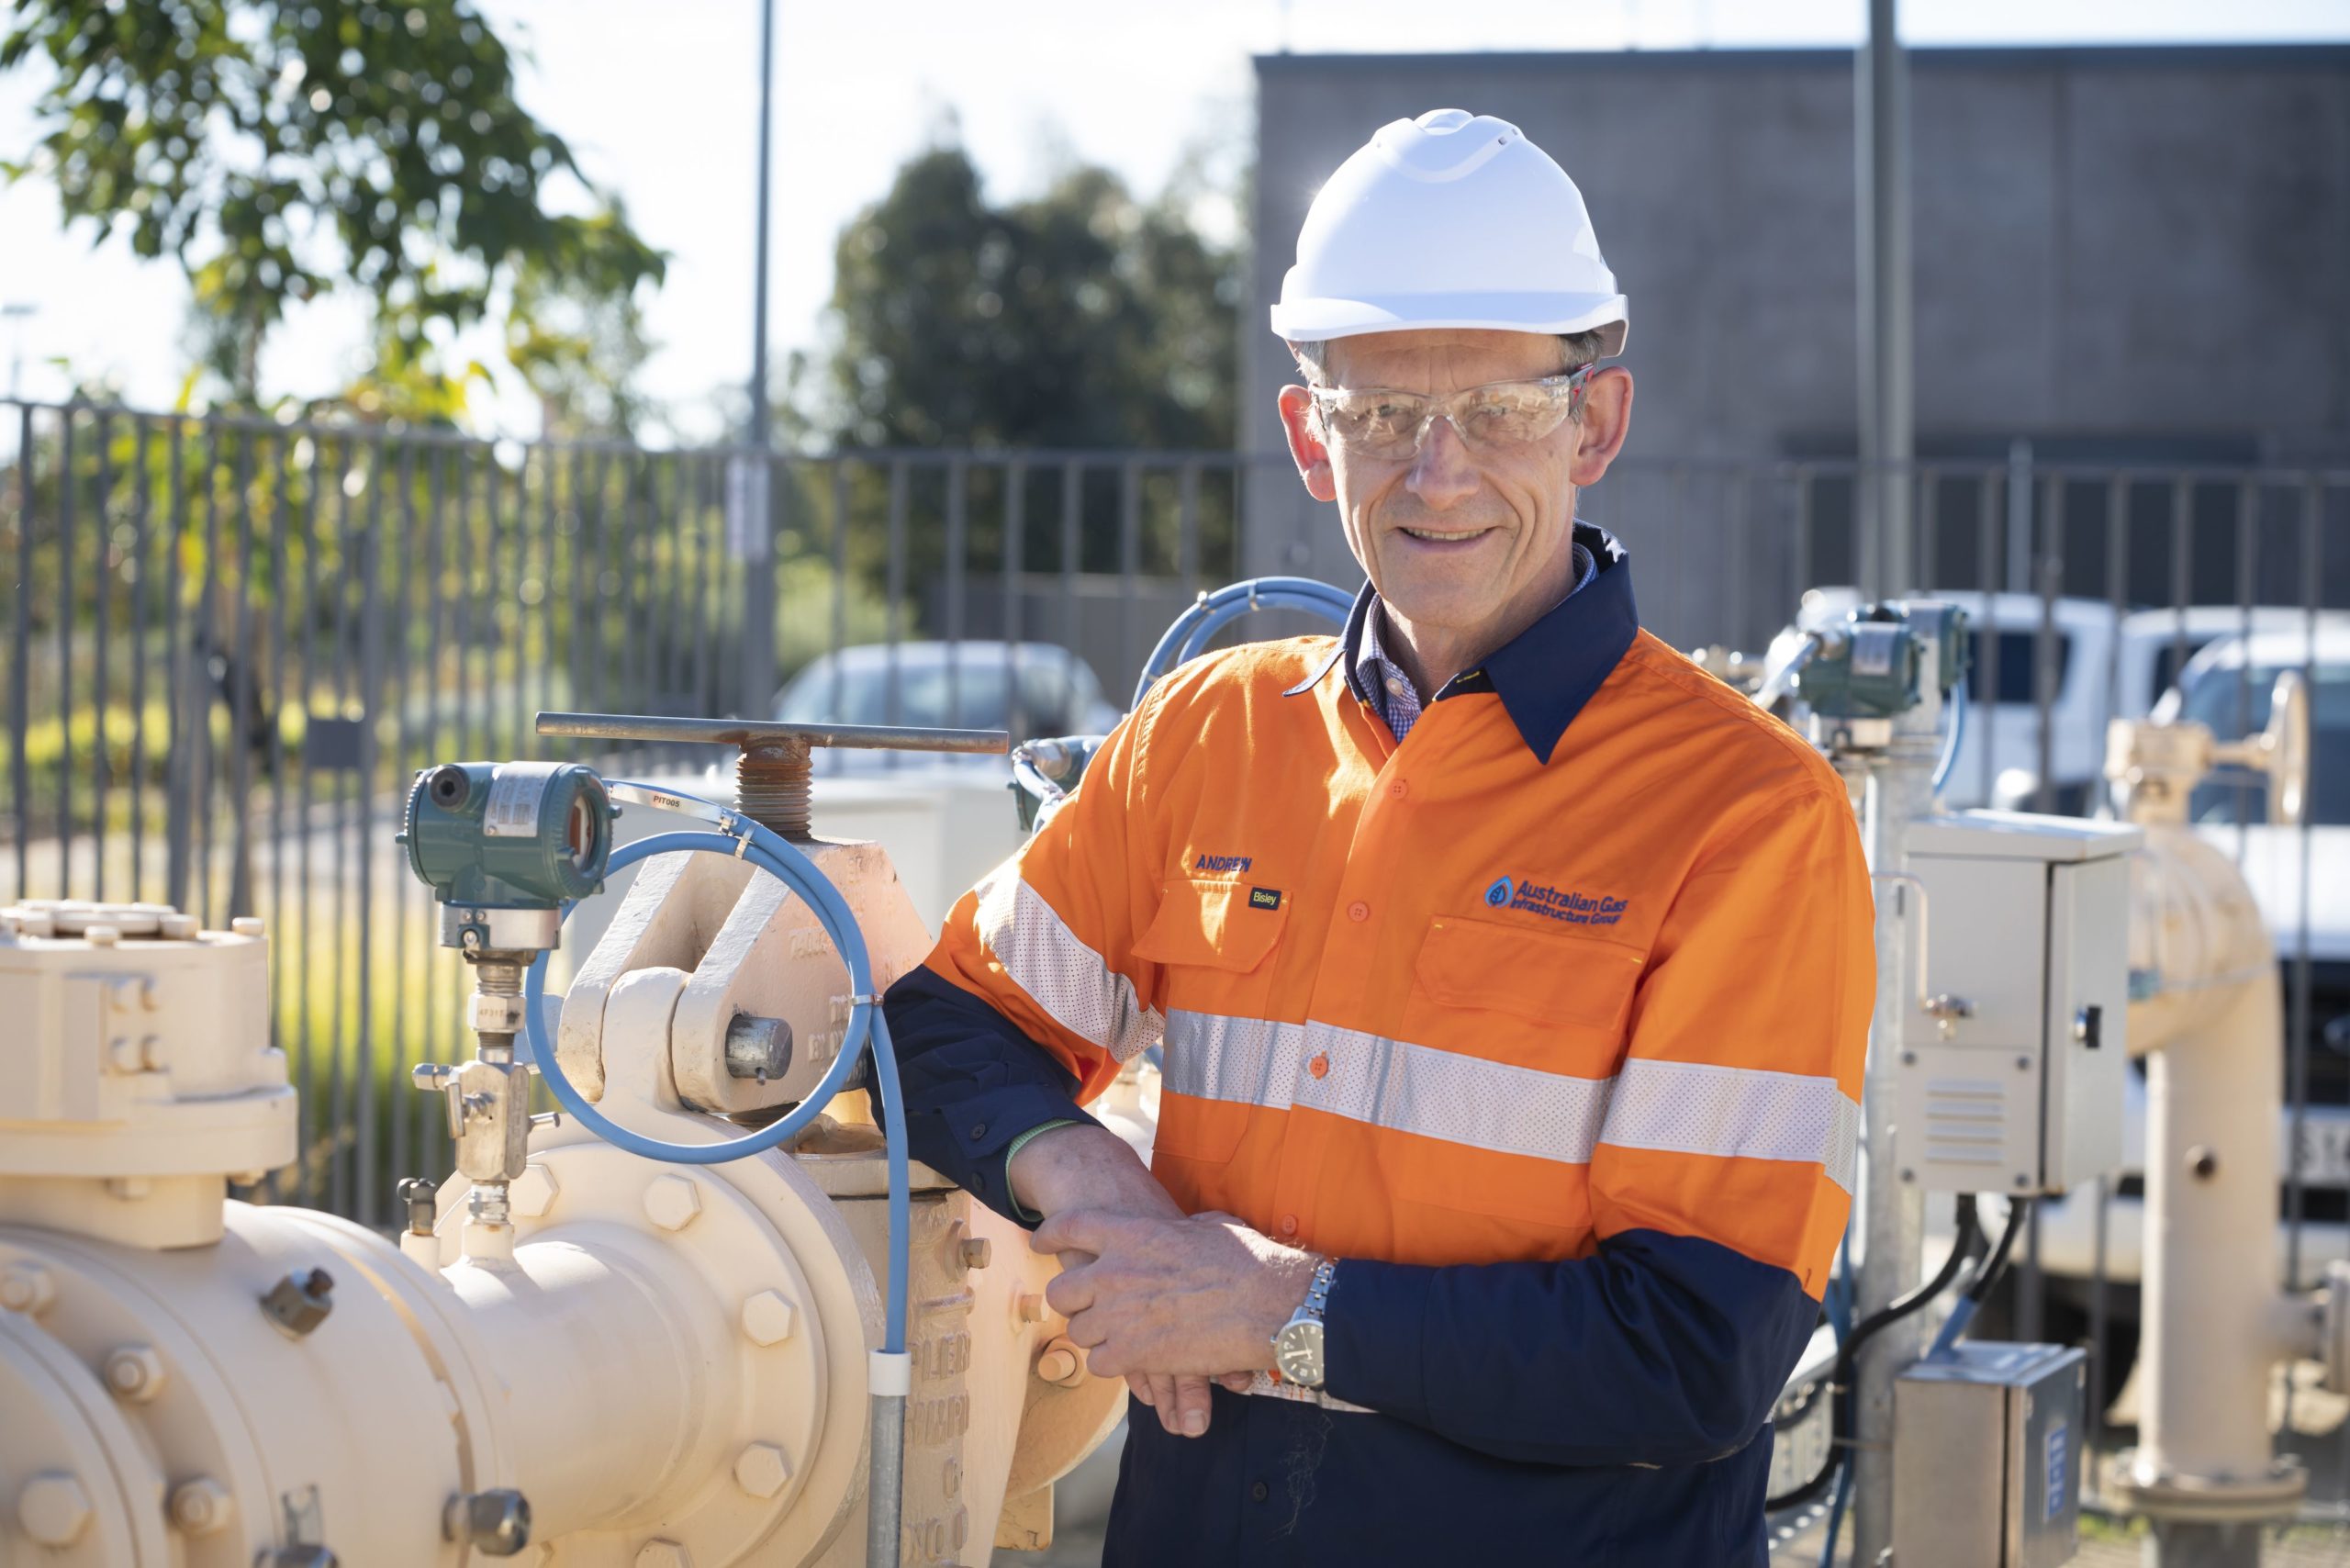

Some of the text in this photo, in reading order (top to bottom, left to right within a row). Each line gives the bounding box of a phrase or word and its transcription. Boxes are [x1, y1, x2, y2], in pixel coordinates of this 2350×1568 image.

[653, 795, 680, 808] PIT005
[1195, 854, 1252, 872] ANDREW
[1253, 891, 1277, 906] Bisley
[1516, 880, 1628, 913] Australian Gas
[1509, 898, 1589, 924] Infrastructure
